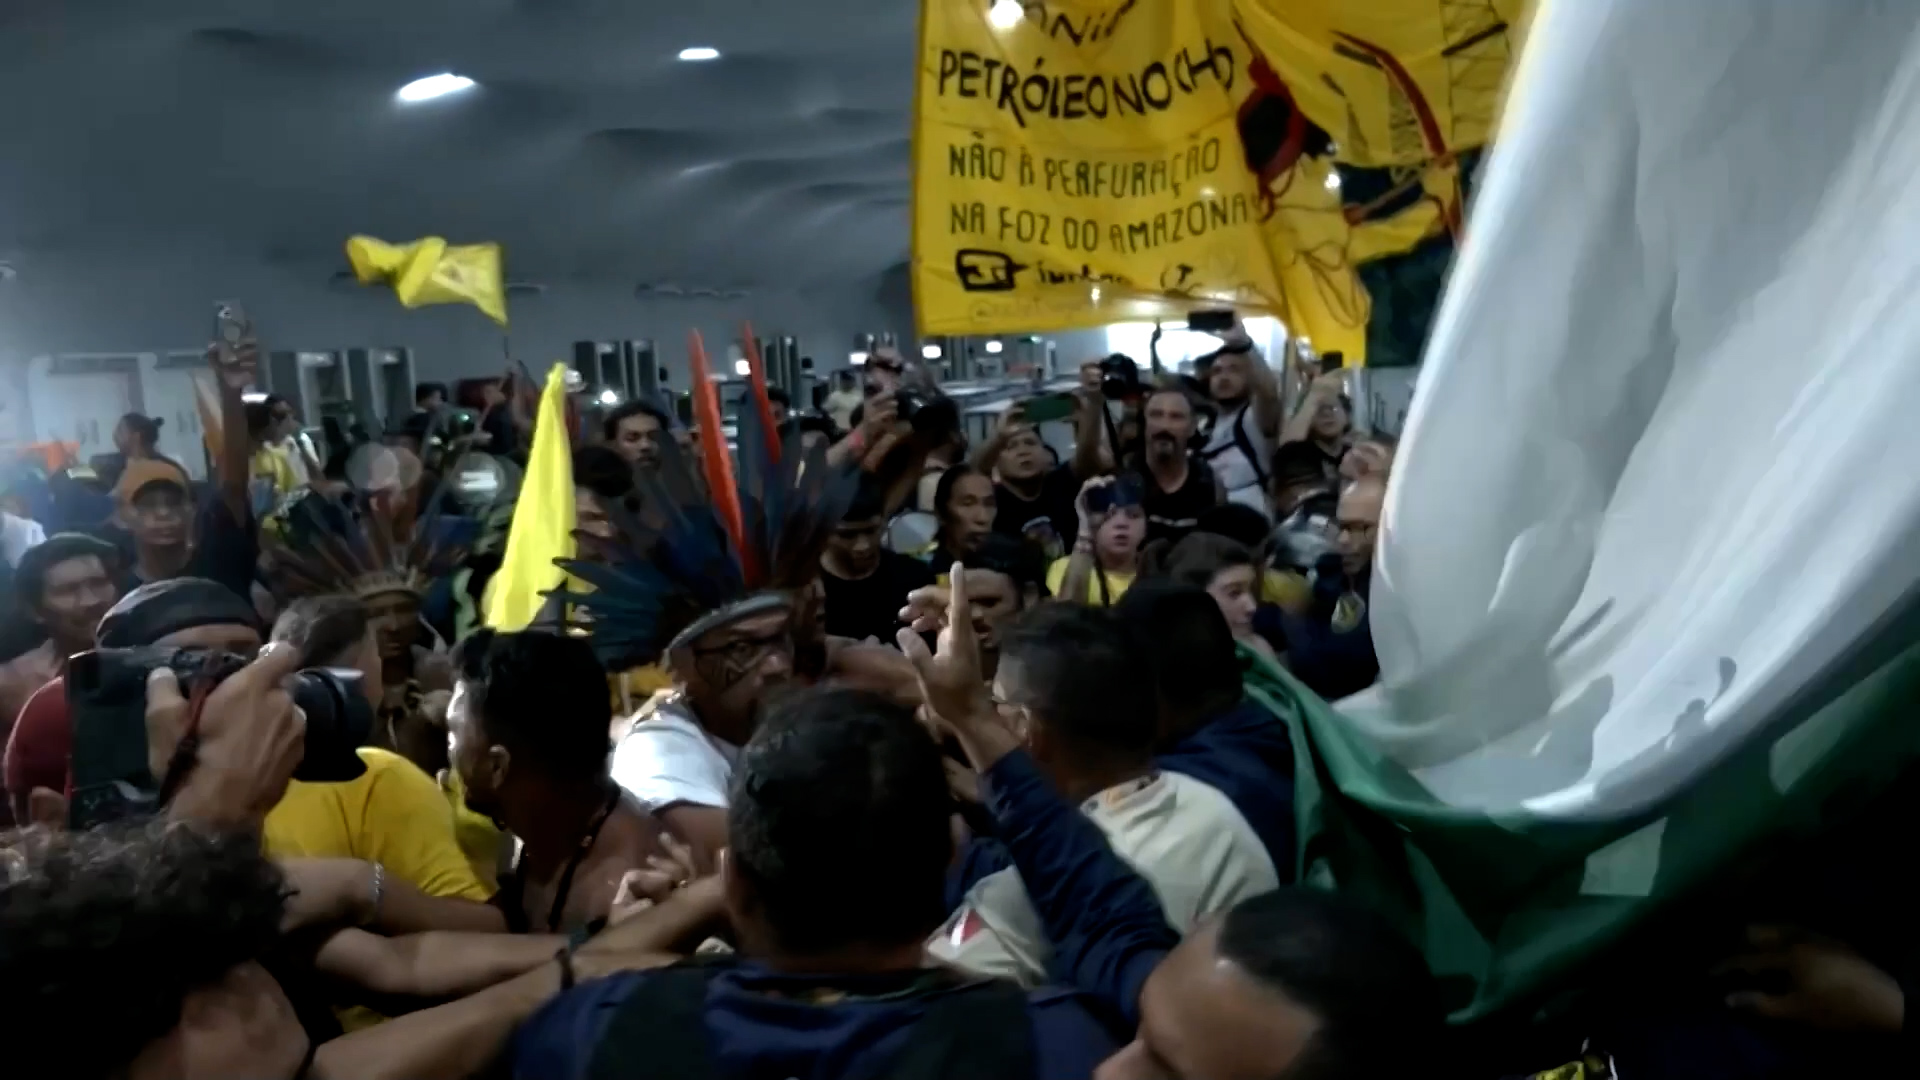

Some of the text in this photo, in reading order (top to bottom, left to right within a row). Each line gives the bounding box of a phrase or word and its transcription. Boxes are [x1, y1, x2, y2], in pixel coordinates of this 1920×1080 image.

[949, 130, 1006, 182] NÃO
[1044, 132, 1220, 199] PERFURAÇÃO
[951, 202, 985, 235] NA
[997, 206, 1050, 246] FOZ
